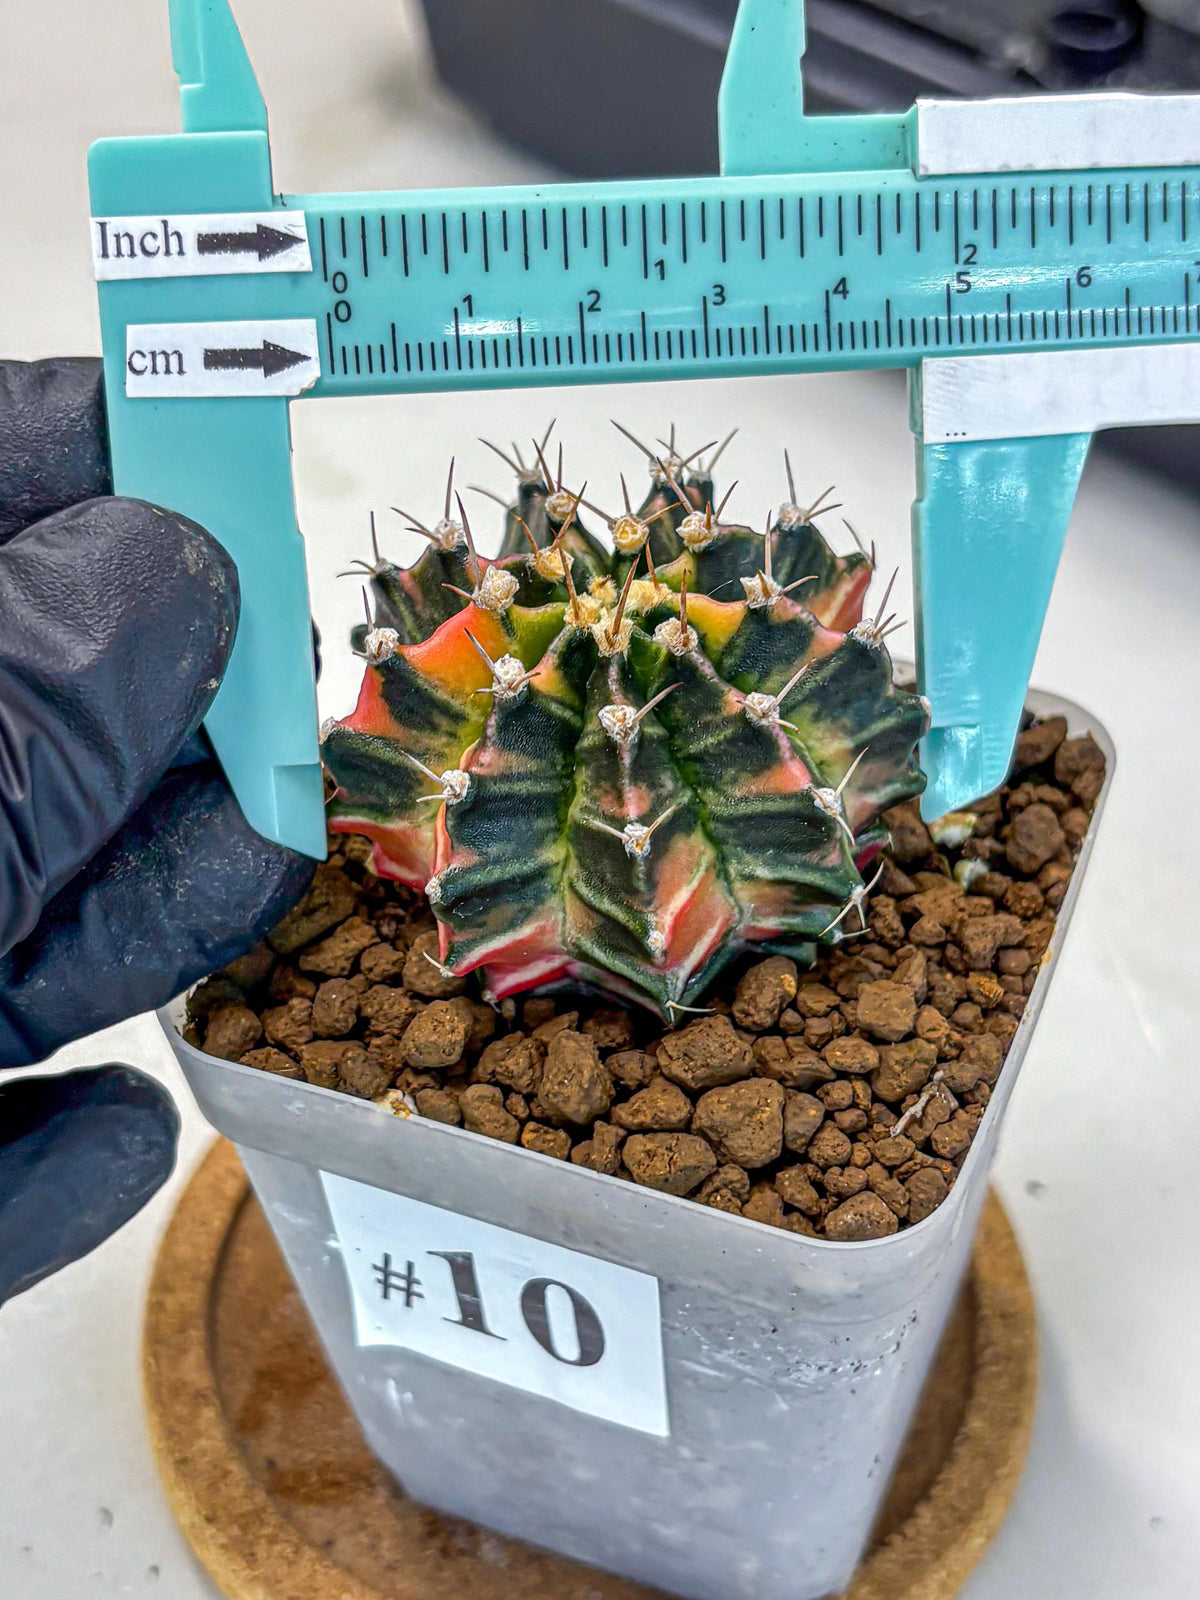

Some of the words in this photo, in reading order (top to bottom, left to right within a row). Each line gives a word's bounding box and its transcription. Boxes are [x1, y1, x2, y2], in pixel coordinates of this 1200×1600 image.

[95, 219, 186, 259] Inch
[332, 271, 348, 294] 0
[654, 259, 666, 281] 1
[962, 243, 978, 266] 2
[334, 300, 351, 322] 0
[463, 294, 474, 318] 1
[586, 290, 602, 312] 2
[712, 284, 726, 305] 3
[832, 276, 850, 300] 4
[955, 271, 972, 294] 5
[1076, 265, 1092, 288] 6
[127, 349, 187, 376] cm
[371, 1250, 606, 1367] #10
